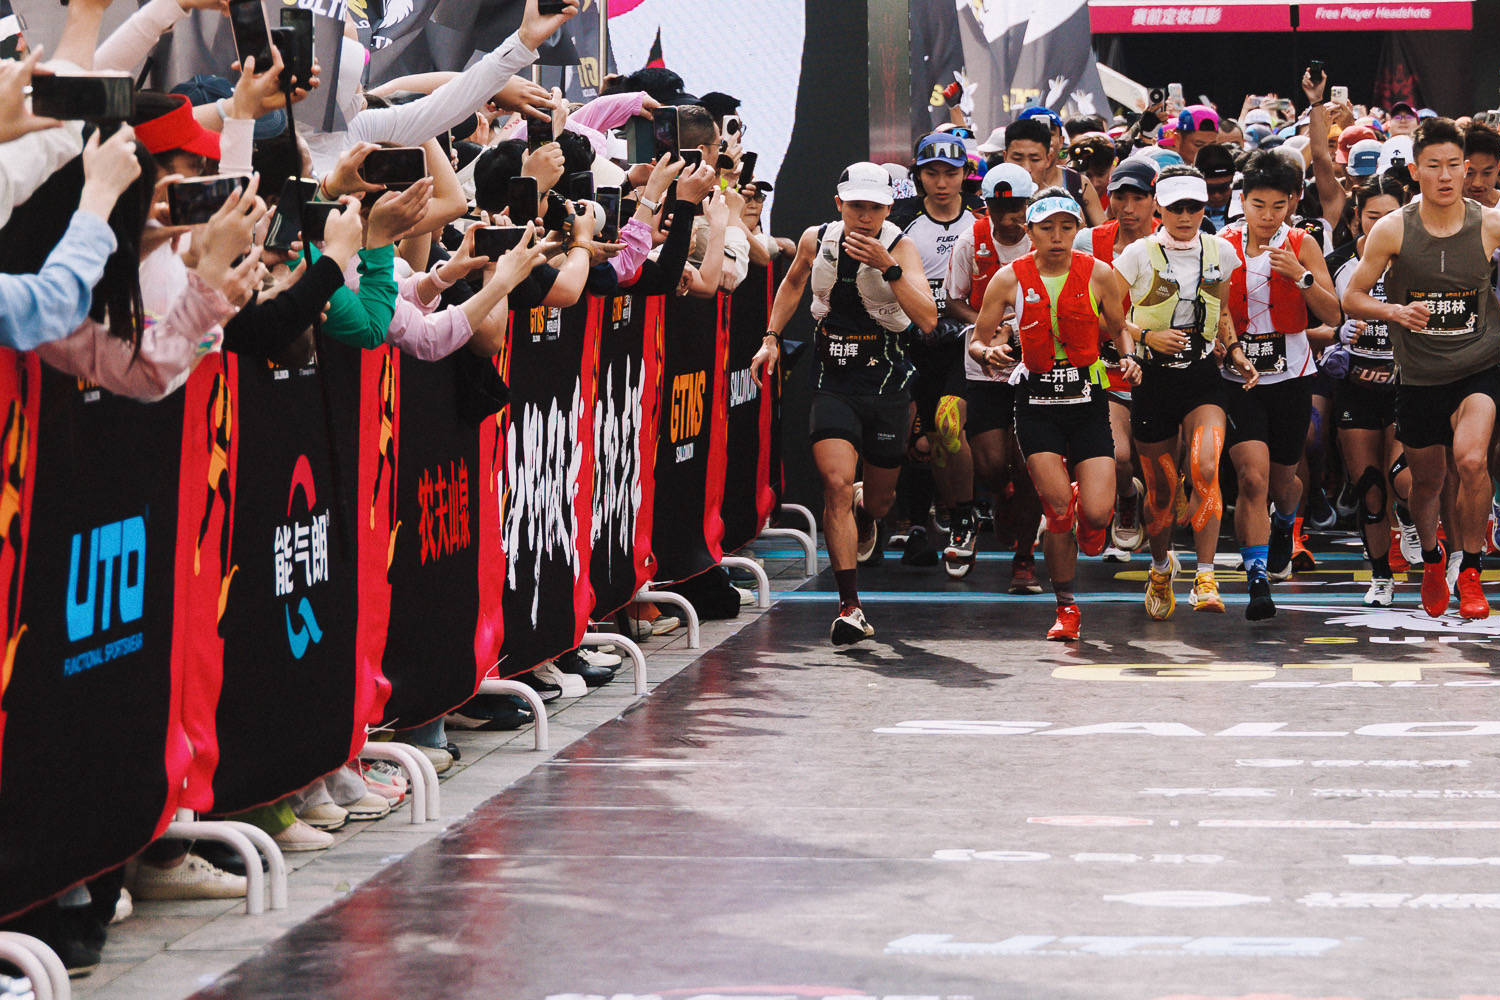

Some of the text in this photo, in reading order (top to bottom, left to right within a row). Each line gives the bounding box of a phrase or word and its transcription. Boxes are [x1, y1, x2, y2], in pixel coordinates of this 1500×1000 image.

[1315, 6, 1432, 22] Free Player Headshots
[936, 235, 959, 243] FUGA
[829, 342, 859, 357] 柏辉
[1054, 384, 1064, 392] 52
[670, 370, 706, 443] GTNS
[418, 457, 471, 566] 农夫山泉
